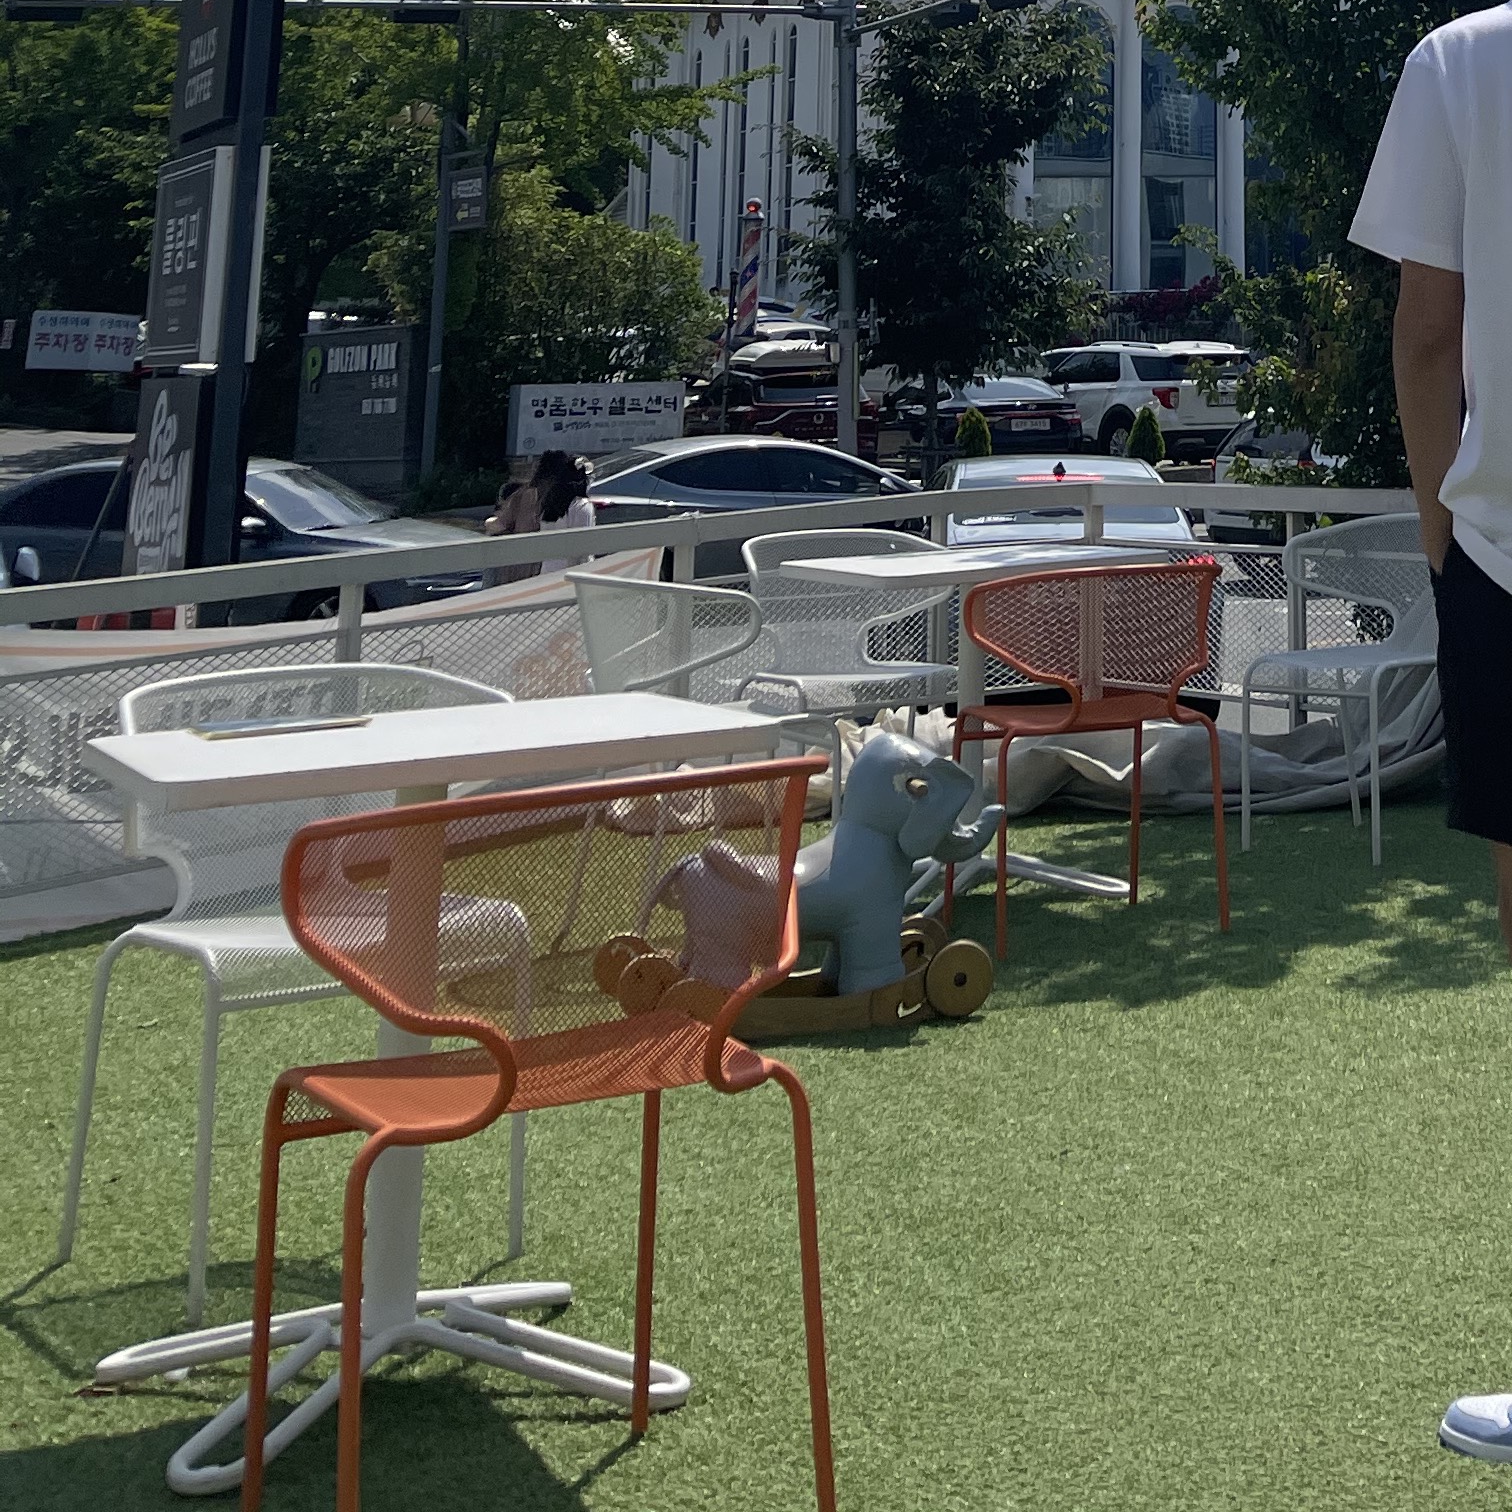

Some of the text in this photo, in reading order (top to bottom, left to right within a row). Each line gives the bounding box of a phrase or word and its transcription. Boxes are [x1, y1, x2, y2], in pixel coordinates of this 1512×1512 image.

[184, 67, 214, 110] COFFEE
[34, 332, 88, 353] 주차장
[94, 333, 135, 357] 주차장
[531, 395, 678, 419] 명품한우 셀프센터
